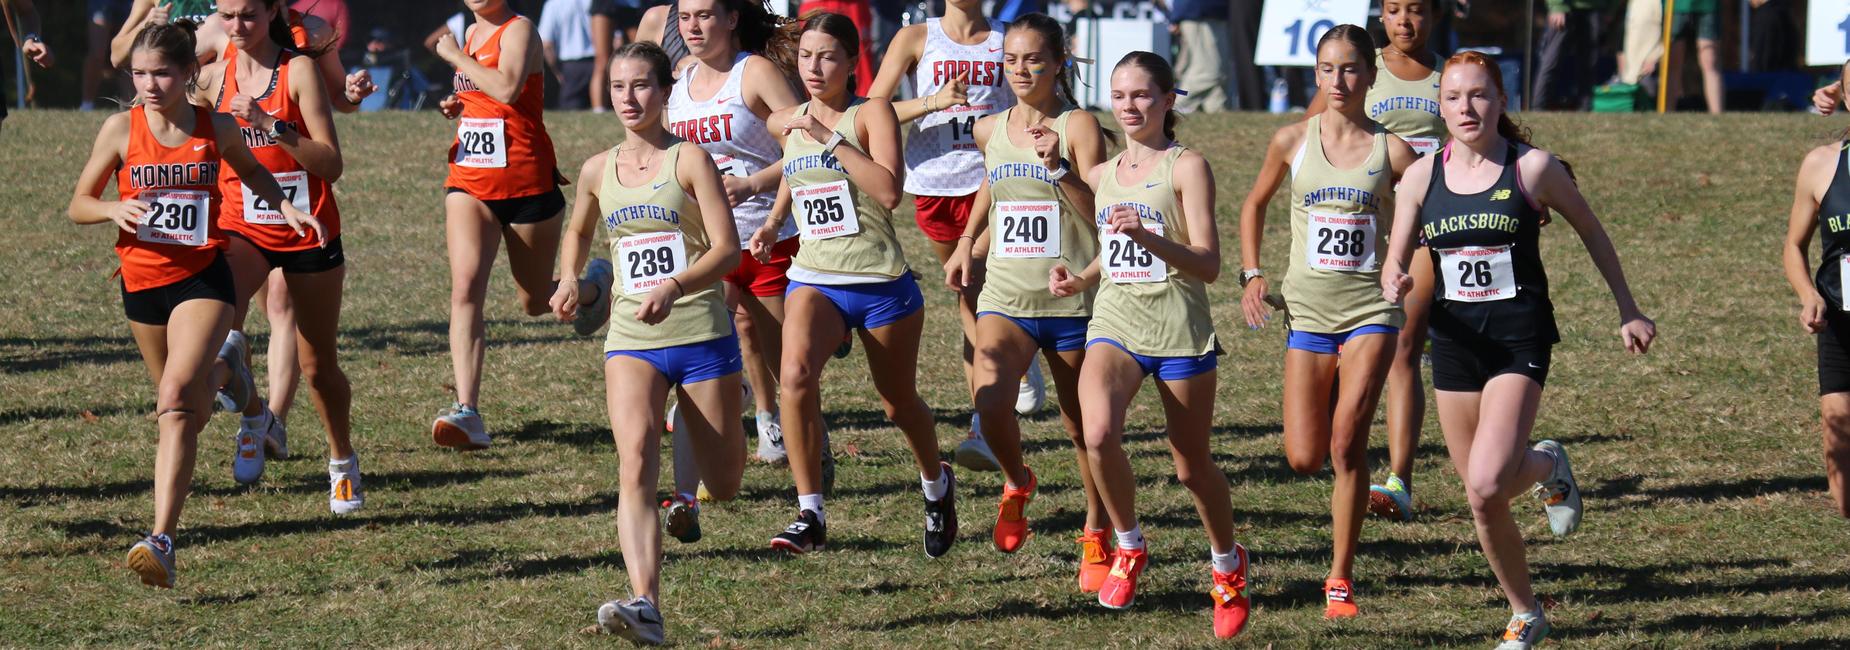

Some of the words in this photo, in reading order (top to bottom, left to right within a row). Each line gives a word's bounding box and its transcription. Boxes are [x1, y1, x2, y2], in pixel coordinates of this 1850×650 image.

[1284, 19, 1335, 56] 10
[933, 60, 1003, 89] FOREST
[671, 114, 734, 145] FOREST
[948, 114, 989, 140] 14
[463, 131, 495, 155] 228
[129, 162, 218, 189] MONACAN
[148, 202, 198, 231] 230
[803, 196, 845, 225] 235
[162, 232, 194, 241] ATHLETIC
[634, 234, 677, 246] CHAMPIONSHIPS
[818, 225, 845, 235] ATHLETIC
[1003, 216, 1048, 243] 240
[1317, 227, 1365, 257] 238
[628, 246, 675, 279] 239
[1015, 246, 1046, 254] ATHLETIC
[1109, 239, 1153, 267] 243
[1330, 259, 1361, 267] ATHLETIC
[1120, 271, 1151, 279] ATHLETIC
[1458, 260, 1493, 288] 26
[1467, 288, 1500, 298] ATHLETIC
